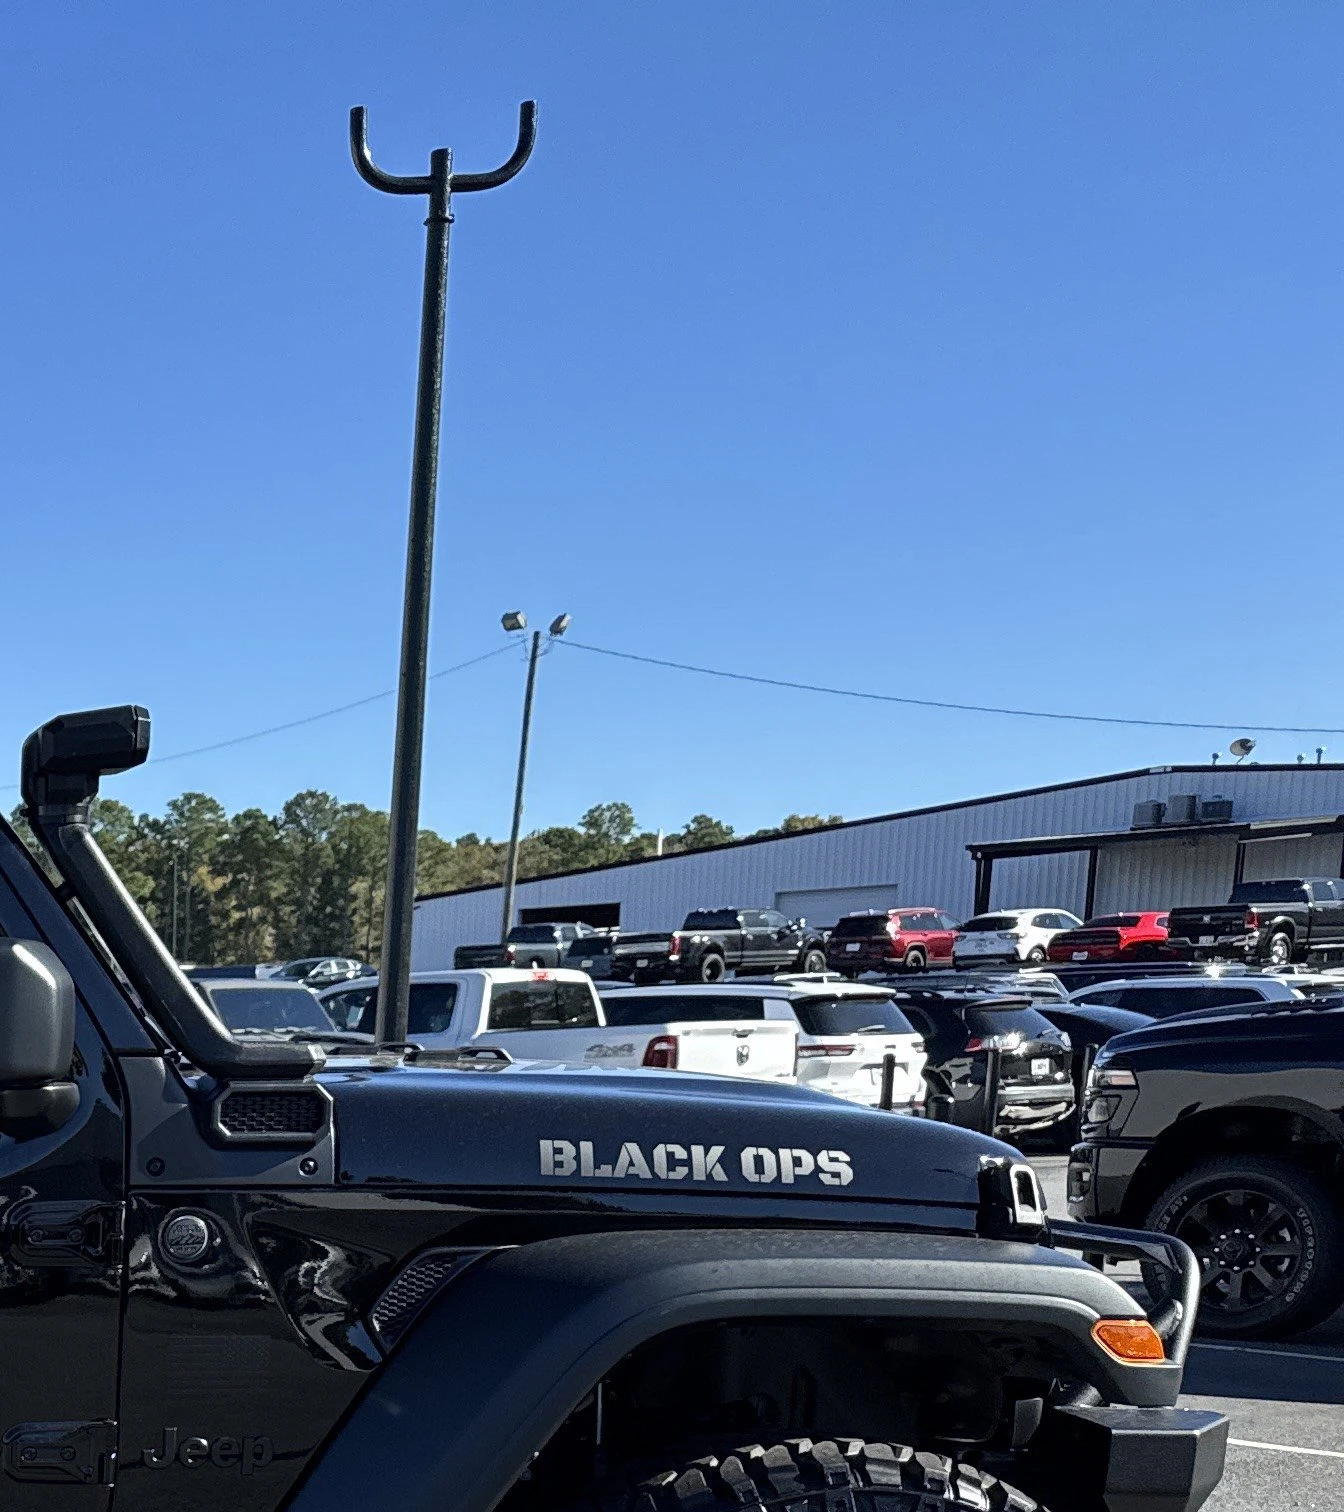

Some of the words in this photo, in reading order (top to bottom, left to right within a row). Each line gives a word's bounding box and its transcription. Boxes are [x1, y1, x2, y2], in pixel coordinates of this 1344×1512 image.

[540, 1139, 726, 1183] BLACK
[740, 1145, 855, 1187] OPS
[143, 1426, 275, 1475] Jeep
